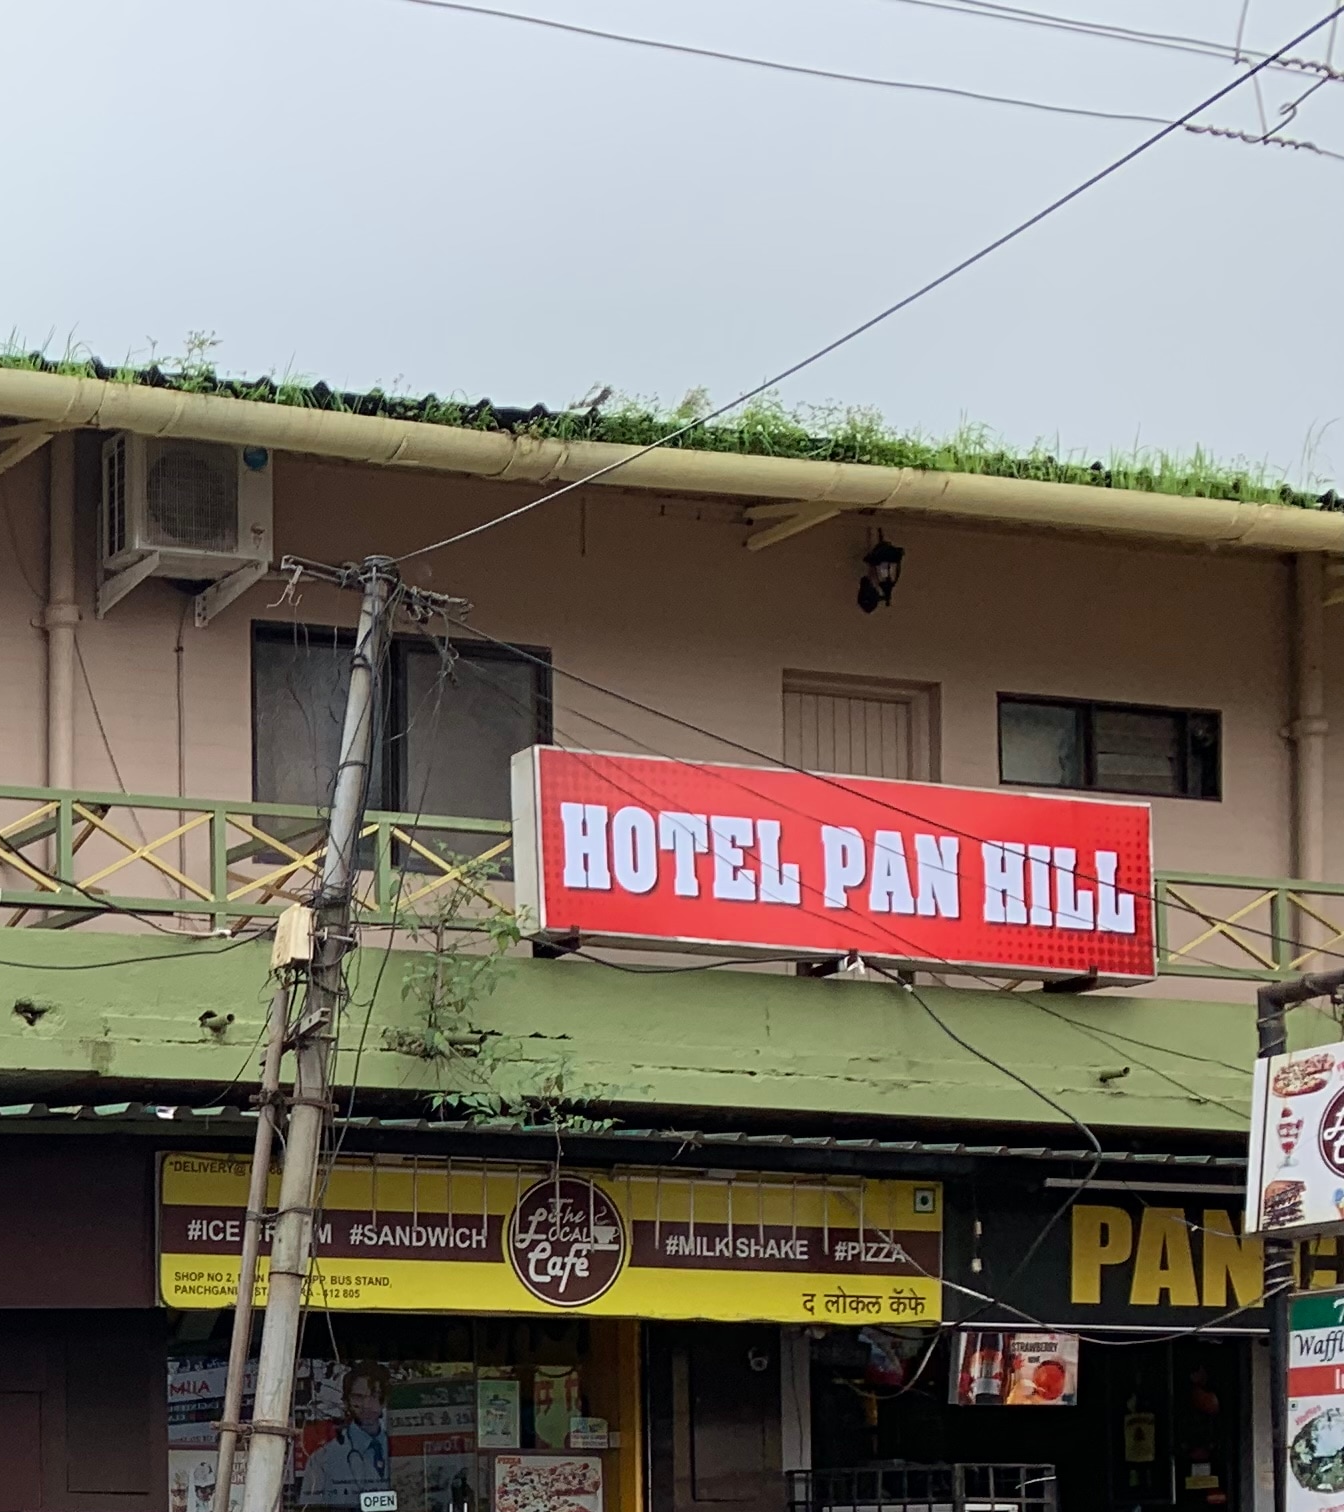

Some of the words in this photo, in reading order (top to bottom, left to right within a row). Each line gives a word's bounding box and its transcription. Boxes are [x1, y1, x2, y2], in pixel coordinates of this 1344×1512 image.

[560, 802, 802, 905] HOTEL
[820, 825, 960, 920] PAN
[981, 840, 1136, 935] HILL
[187, 1219, 240, 1242] #ICE
[350, 1223, 487, 1249] #SANDWICH
[666, 1235, 730, 1258] #MILK
[736, 1237, 809, 1260] SHAKE
[834, 1241, 907, 1263] #PIZZA
[174, 1272, 205, 1282] SHOP
[207, 1273, 223, 1282] NO
[528, 1241, 590, 1293] Café
[330, 1275, 352, 1285] BUS
[342, 1290, 360, 1299] 805
[802, 1293, 816, 1316] द
[824, 1286, 883, 1315] लोकल
[363, 1494, 395, 1508] OPEN
